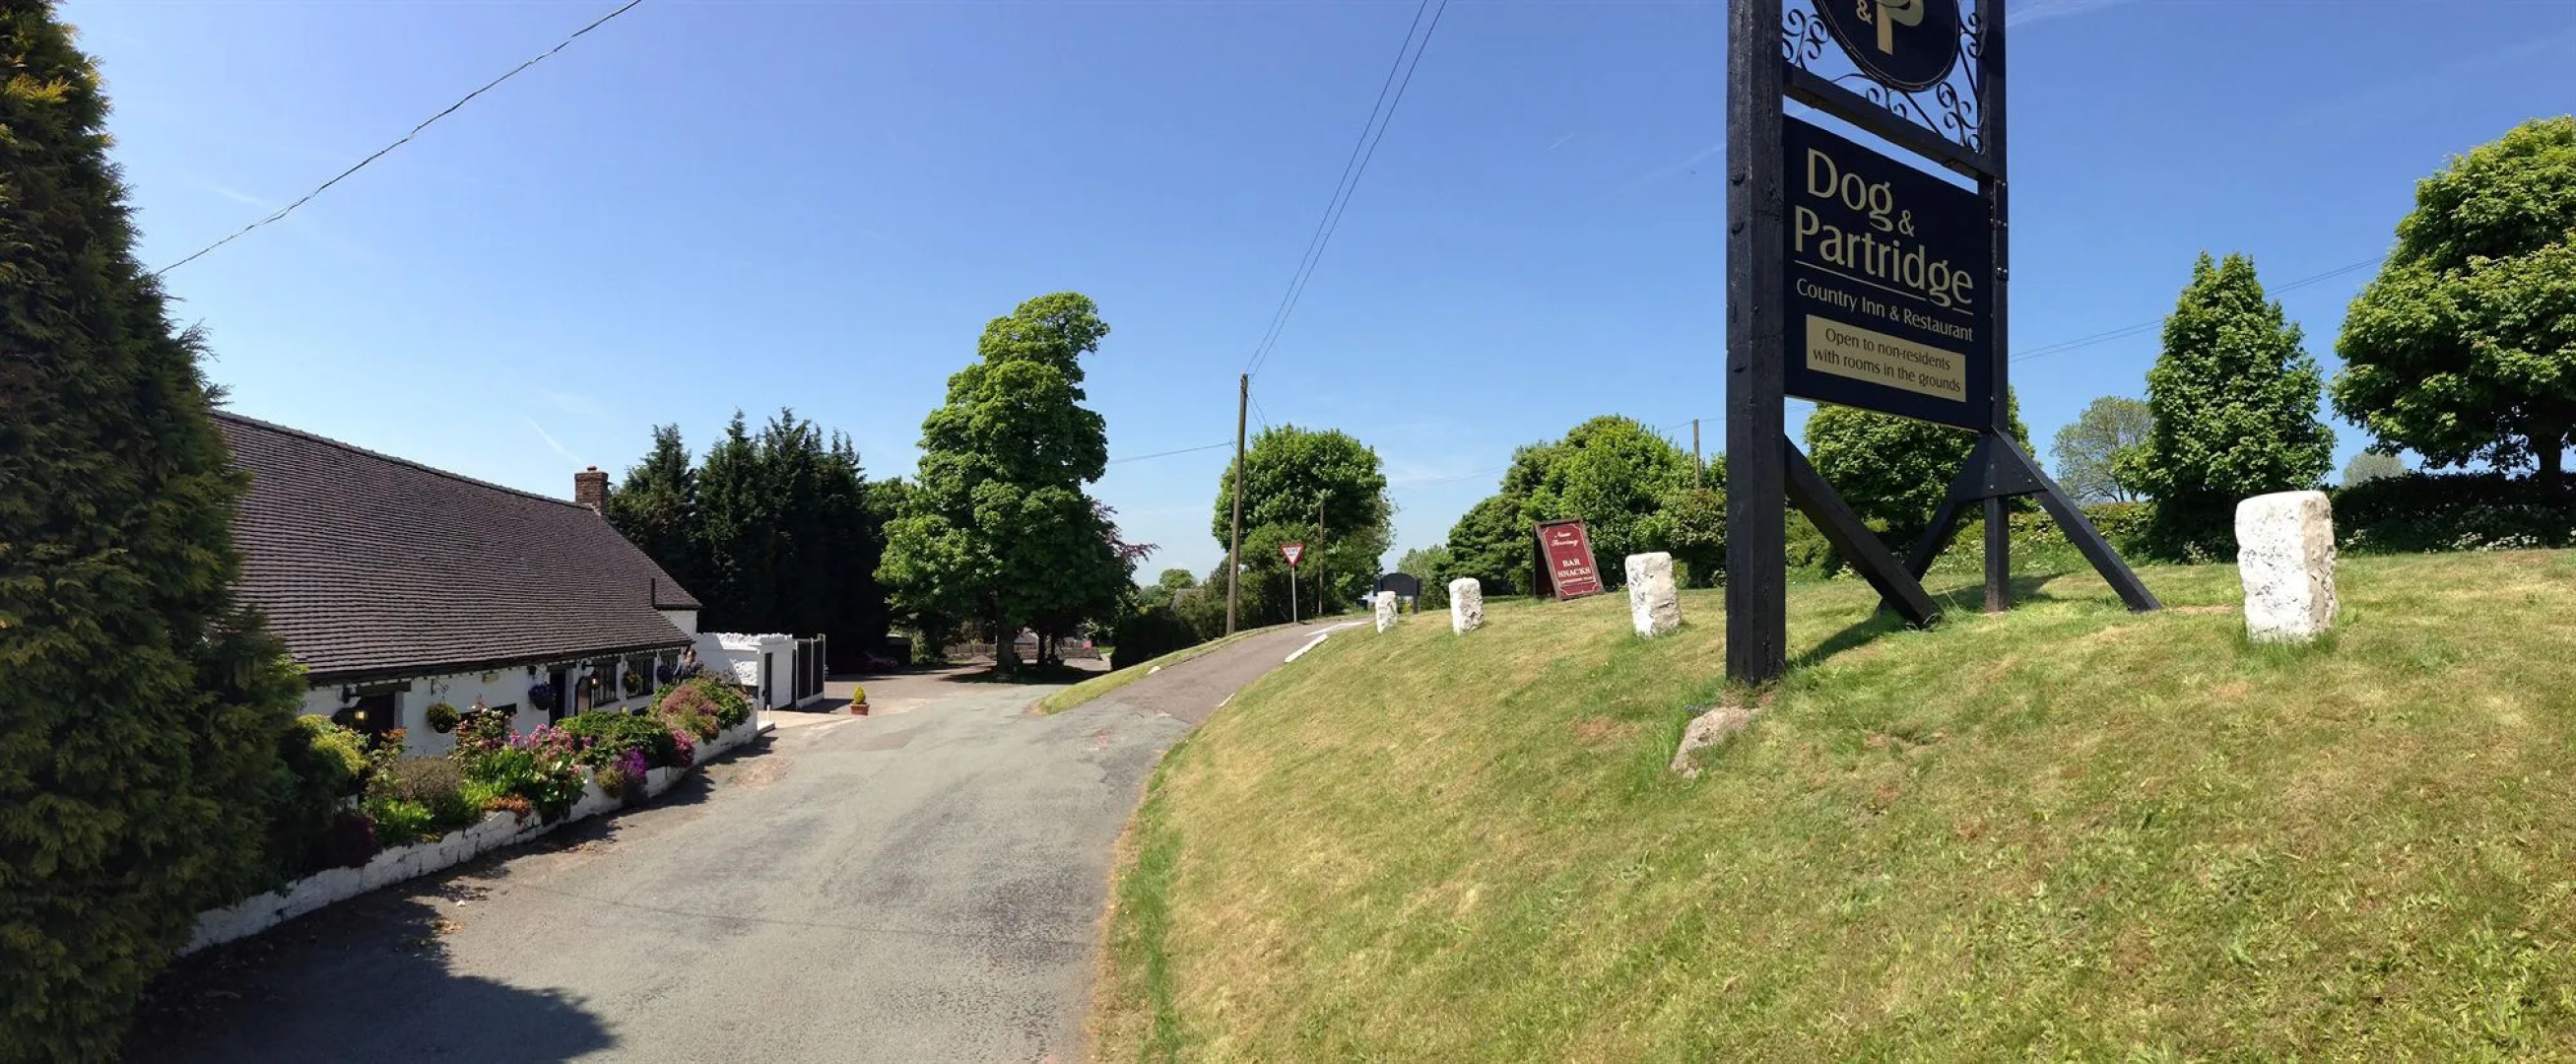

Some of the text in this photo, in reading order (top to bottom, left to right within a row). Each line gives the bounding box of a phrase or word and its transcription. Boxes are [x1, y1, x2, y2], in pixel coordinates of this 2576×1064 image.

[1807, 148, 1915, 237] Dog &
[1795, 205, 1973, 307] Partridge
[1796, 278, 1973, 343] Country Inn & Restaurant
[1825, 327, 1951, 370] Open to non-residents
[1813, 349, 1961, 392] with rooms in the grounds
[1557, 566, 1591, 577] SNACKS
[1562, 559, 1581, 567] BAR
